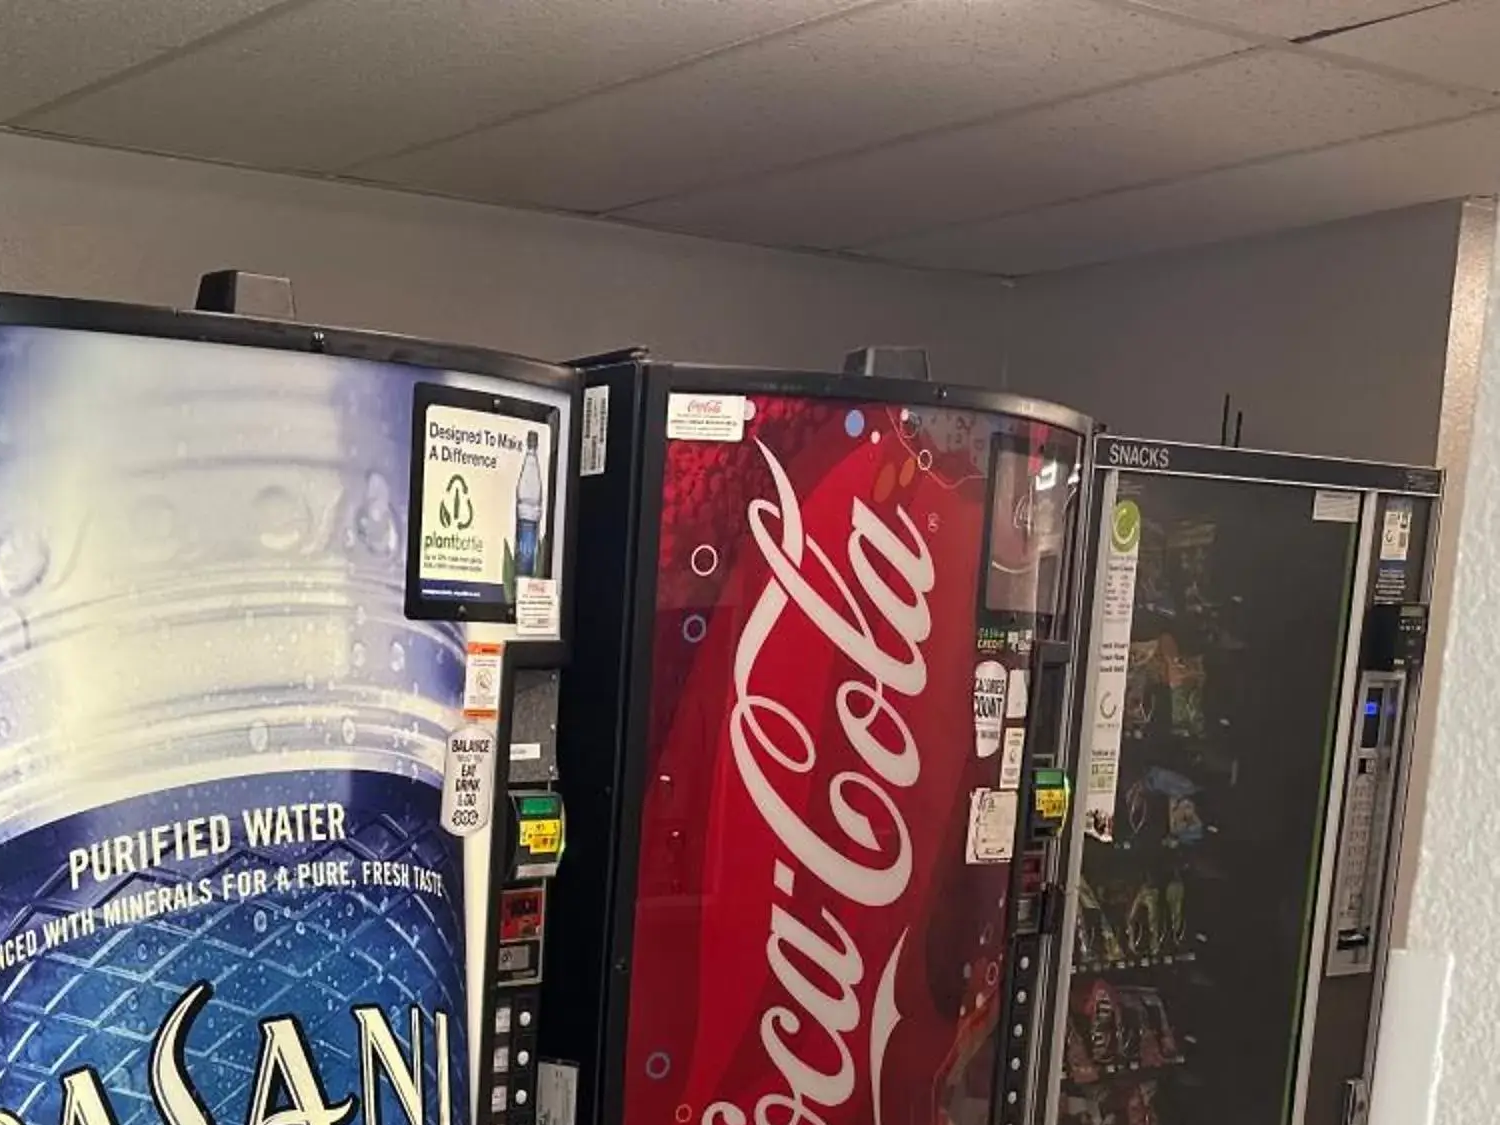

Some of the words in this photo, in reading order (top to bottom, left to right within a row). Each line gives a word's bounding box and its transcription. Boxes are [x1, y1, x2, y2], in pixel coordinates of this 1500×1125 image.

[429, 421, 482, 446] Designed
[483, 430, 495, 447] To
[498, 431, 523, 453] Make
[429, 444, 439, 461] A
[441, 446, 498, 468] Difference
[1108, 442, 1170, 469] SNACKS
[424, 529, 484, 552] plantbottle
[451, 739, 491, 753] BALANCE
[461, 763, 477, 777] EAT
[455, 777, 481, 793] DRINK
[68, 814, 231, 891] PURIFIED
[241, 802, 346, 848] WATER
[43, 907, 95, 949] WITH
[102, 877, 214, 929] MINERALS
[222, 869, 268, 900] FOR
[276, 865, 291, 892] A
[298, 860, 357, 889] PURE,
[361, 860, 410, 888] FRESH
[412, 865, 443, 898] TASTE
